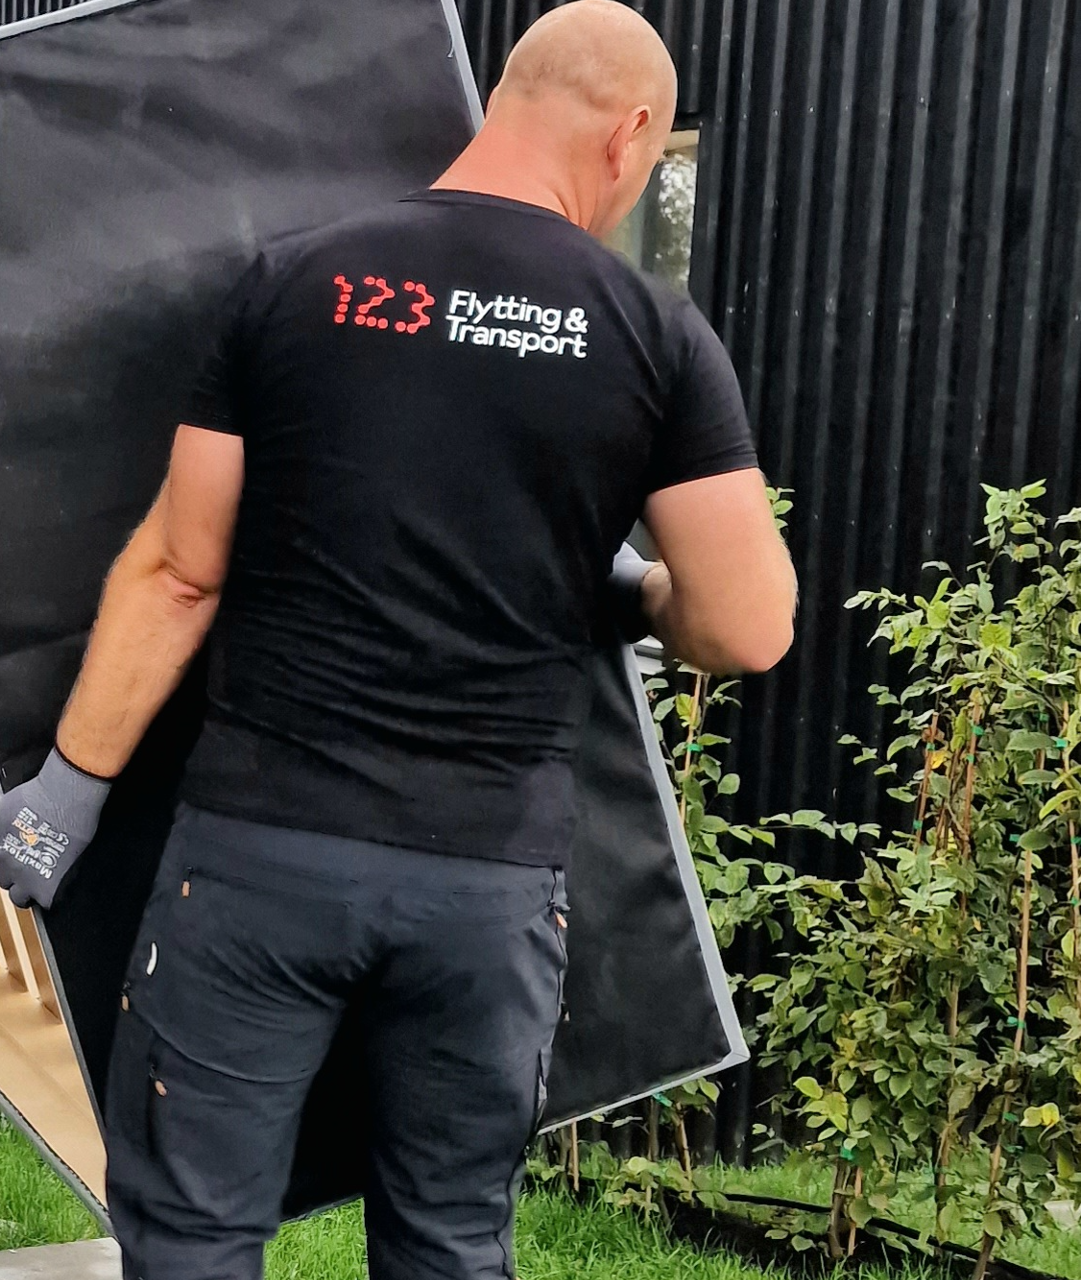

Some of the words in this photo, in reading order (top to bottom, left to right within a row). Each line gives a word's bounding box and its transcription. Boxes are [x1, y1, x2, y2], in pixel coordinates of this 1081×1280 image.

[332, 273, 436, 334] 123
[448, 288, 563, 334] Flytting
[564, 306, 590, 334] &
[444, 314, 589, 359] Transport
